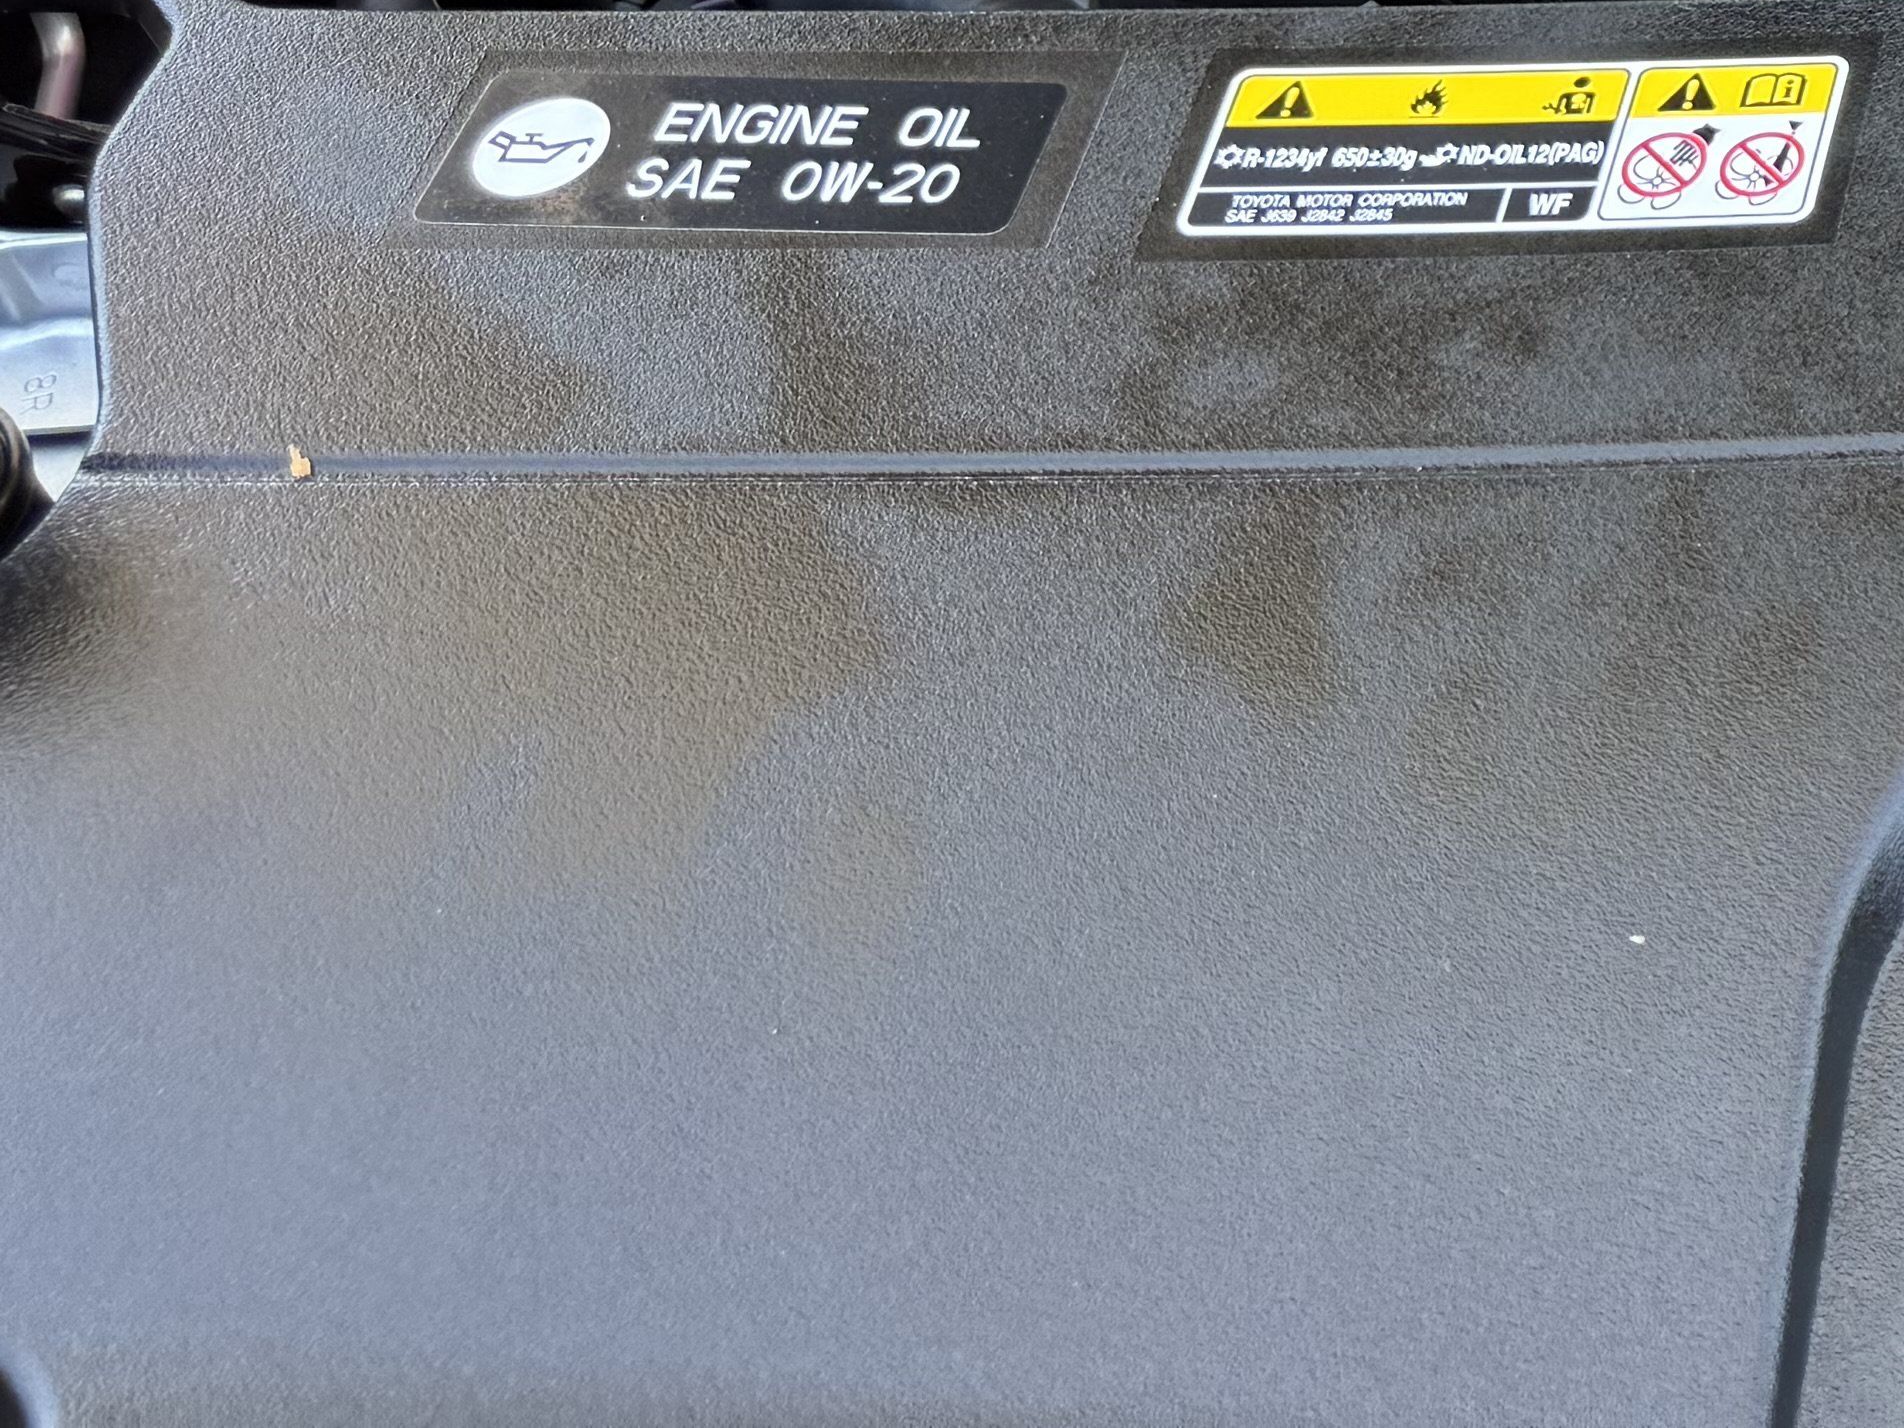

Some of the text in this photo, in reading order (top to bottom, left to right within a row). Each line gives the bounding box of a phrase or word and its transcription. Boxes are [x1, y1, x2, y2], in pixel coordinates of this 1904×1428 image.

[652, 101, 982, 150] ENGINE OIL
[1241, 146, 1329, 173] R-1234yf
[625, 158, 963, 205] SAE 0W-20
[1231, 191, 1468, 208] TOYOTA MOTOR CORPORATION
[1528, 192, 1574, 216] WF
[1224, 209, 1258, 223] SAE
